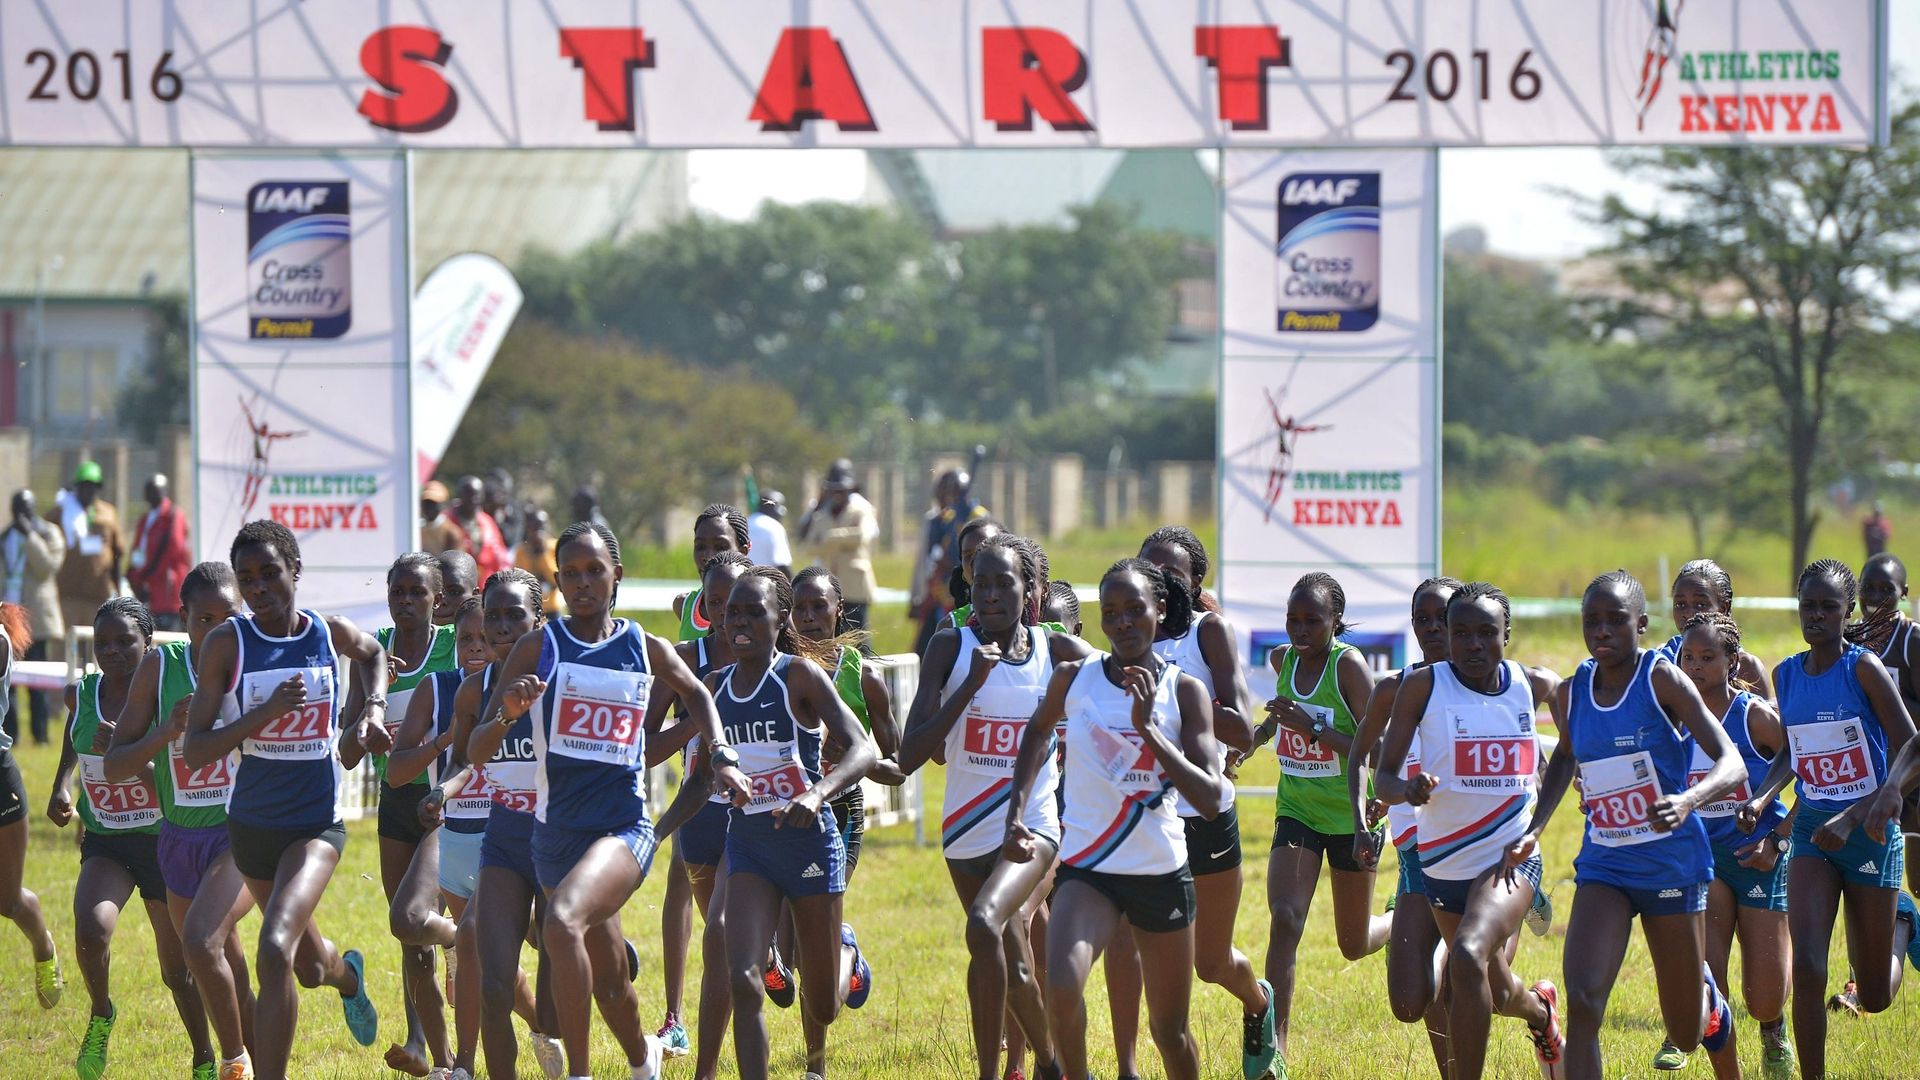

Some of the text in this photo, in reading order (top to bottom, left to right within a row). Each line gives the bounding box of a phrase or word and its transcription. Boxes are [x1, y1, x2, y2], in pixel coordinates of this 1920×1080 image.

[25, 48, 184, 102] 2016
[358, 24, 1290, 132] START
[1385, 50, 1542, 101] 2016
[1680, 51, 1840, 81] ATHLETICS
[1680, 95, 1841, 132] KENYA
[253, 187, 329, 213] IAAF
[1283, 179, 1361, 206] IAAF
[262, 260, 324, 281] Cross
[1291, 252, 1353, 273] Cross
[256, 283, 343, 308] Country
[1284, 275, 1373, 305] Country
[256, 318, 314, 337] Permit
[1282, 311, 1341, 330] Permit
[269, 475, 377, 496] ATHLETICS
[1293, 472, 1402, 491] ATHLETICS
[269, 503, 378, 529] KENYA
[1293, 500, 1402, 526] KENYA
[569, 703, 633, 740] 203
[723, 720, 778, 745] OLICE
[255, 742, 324, 753] NAIROBI 2016
[562, 738, 603, 752] NAIROBI
[1285, 731, 1324, 759] 194
[968, 755, 1007, 769] NAIROBI
[1468, 743, 1521, 773] 191
[1805, 753, 1857, 784] 184
[185, 789, 223, 800] NAIROBI
[752, 773, 794, 798] 26
[1461, 779, 1501, 788] NAIROBI
[1842, 782, 1866, 793] 2016
[95, 785, 150, 810] 219
[1595, 791, 1648, 825] 180
[133, 811, 155, 821] 2016
[801, 870, 824, 878] adidas
